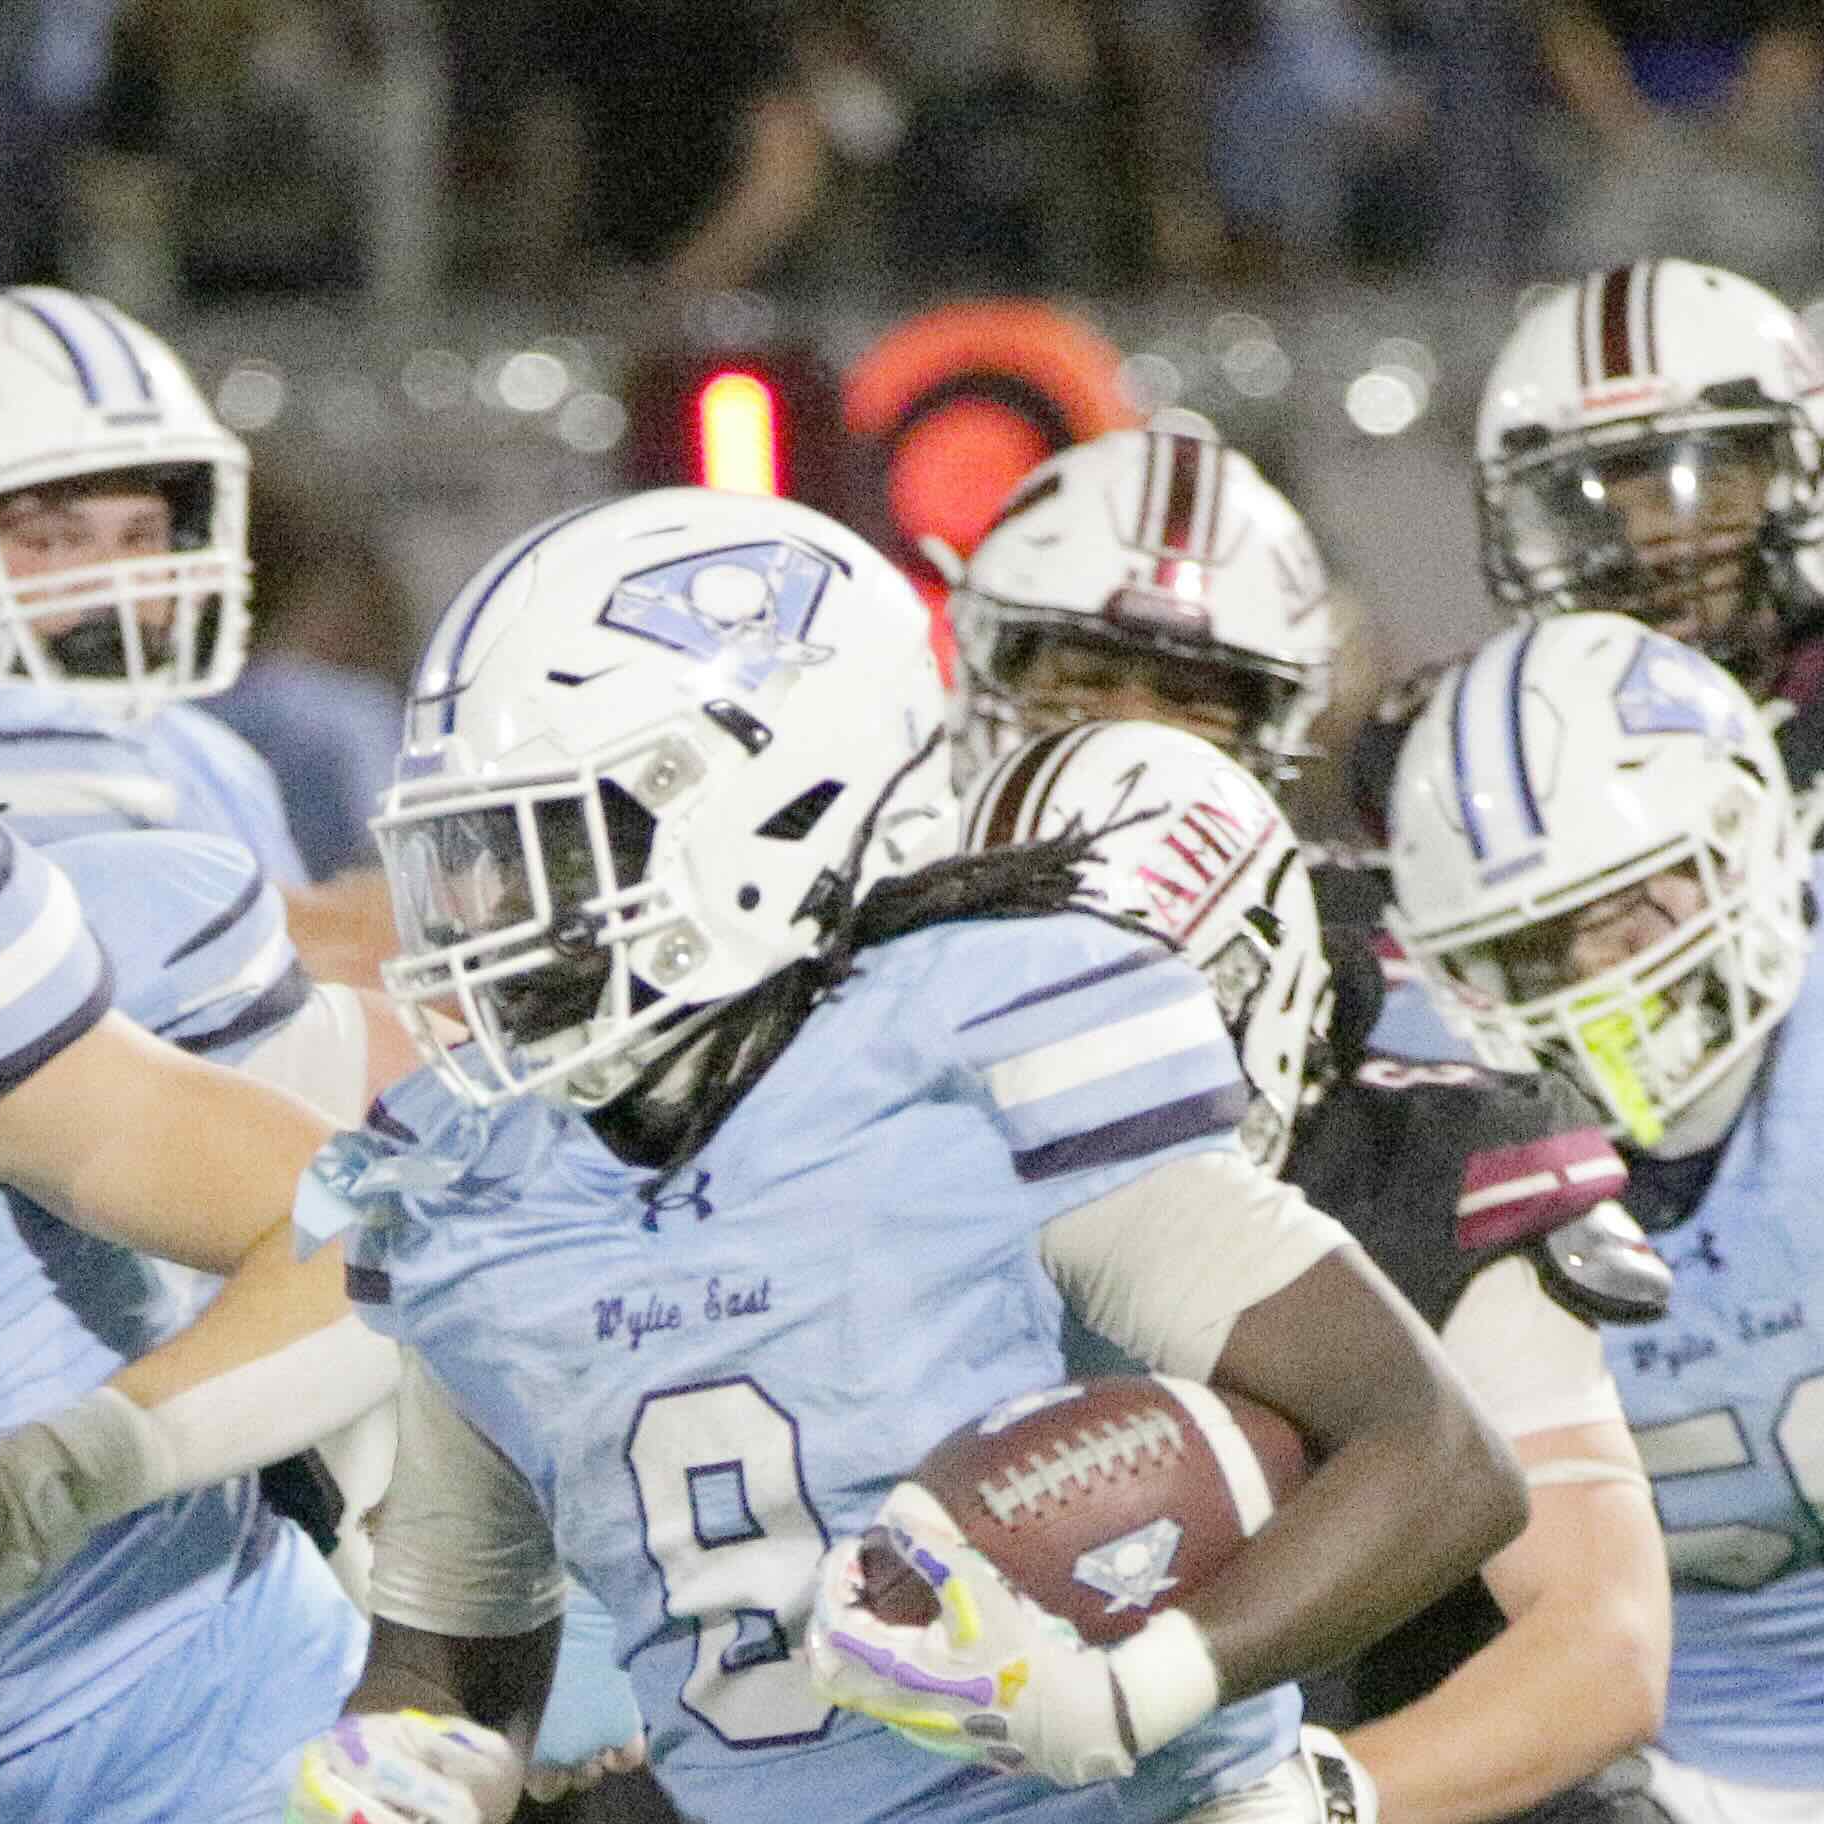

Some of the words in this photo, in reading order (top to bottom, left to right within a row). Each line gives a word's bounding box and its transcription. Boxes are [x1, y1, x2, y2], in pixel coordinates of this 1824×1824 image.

[592, 1293, 682, 1351] Wylie
[703, 1276, 771, 1322] East
[625, 1374, 838, 1751] 8
